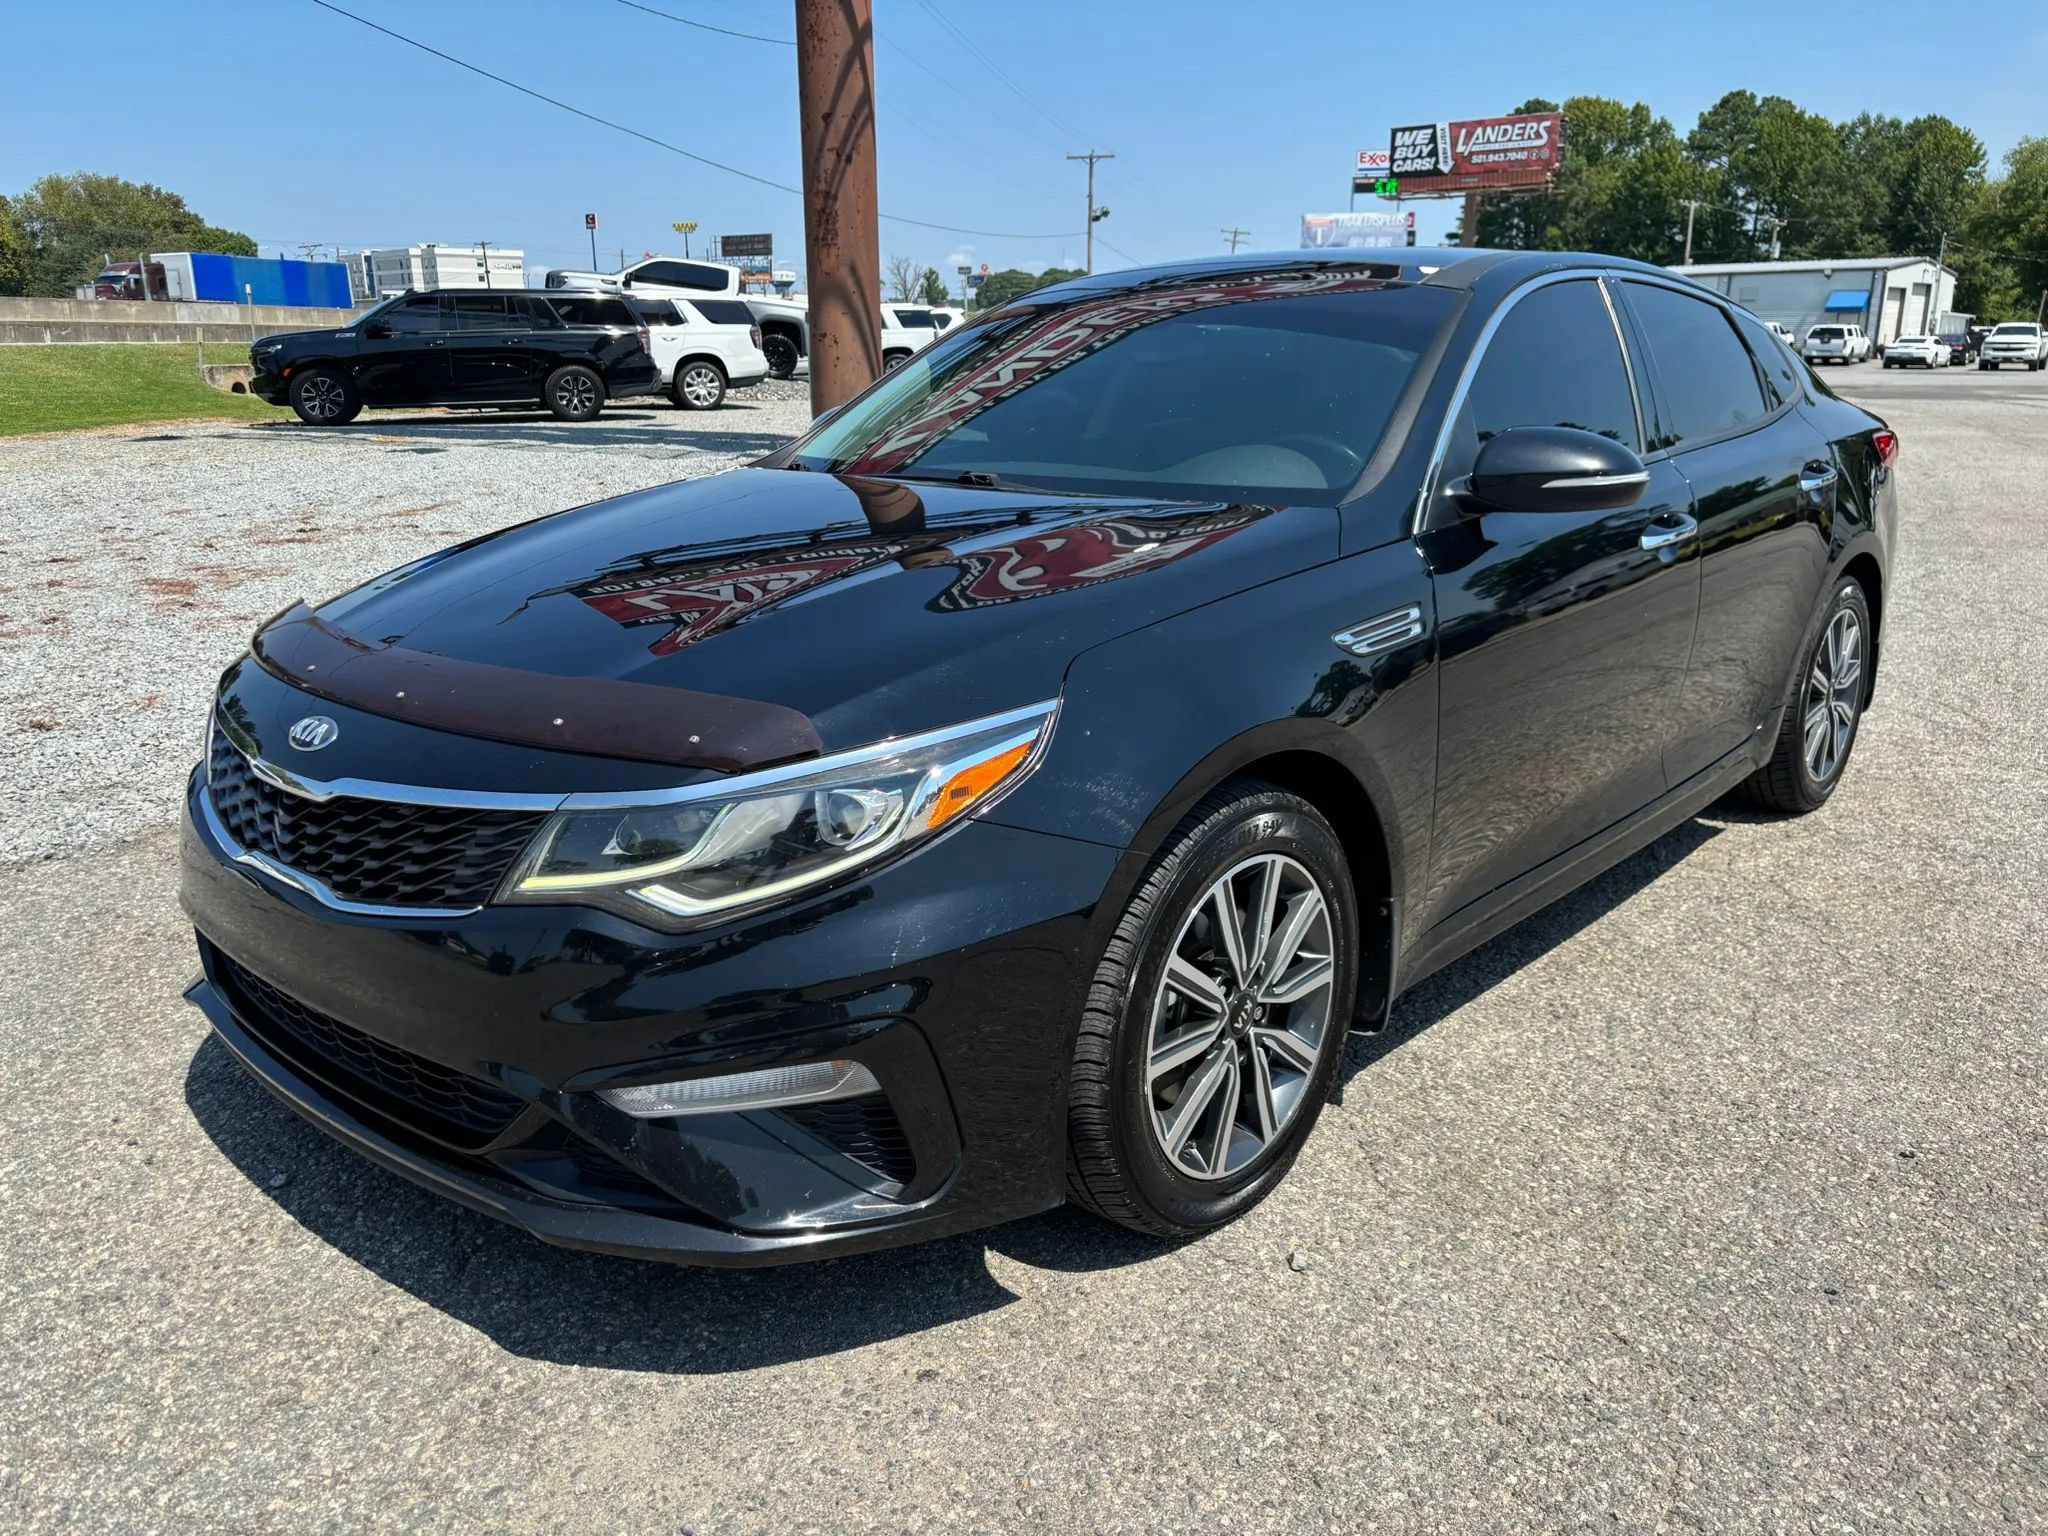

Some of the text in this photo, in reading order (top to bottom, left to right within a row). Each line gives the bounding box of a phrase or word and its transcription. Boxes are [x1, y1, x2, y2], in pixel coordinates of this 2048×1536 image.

[1394, 128, 1434, 147] WE
[1456, 121, 1552, 156] LANDERS
[1359, 151, 1391, 166] Exxo
[1393, 143, 1434, 160] BUY
[1392, 157, 1436, 173] CARS!
[291, 719, 329, 745] KIA
[1233, 999, 1253, 1029] KIA
